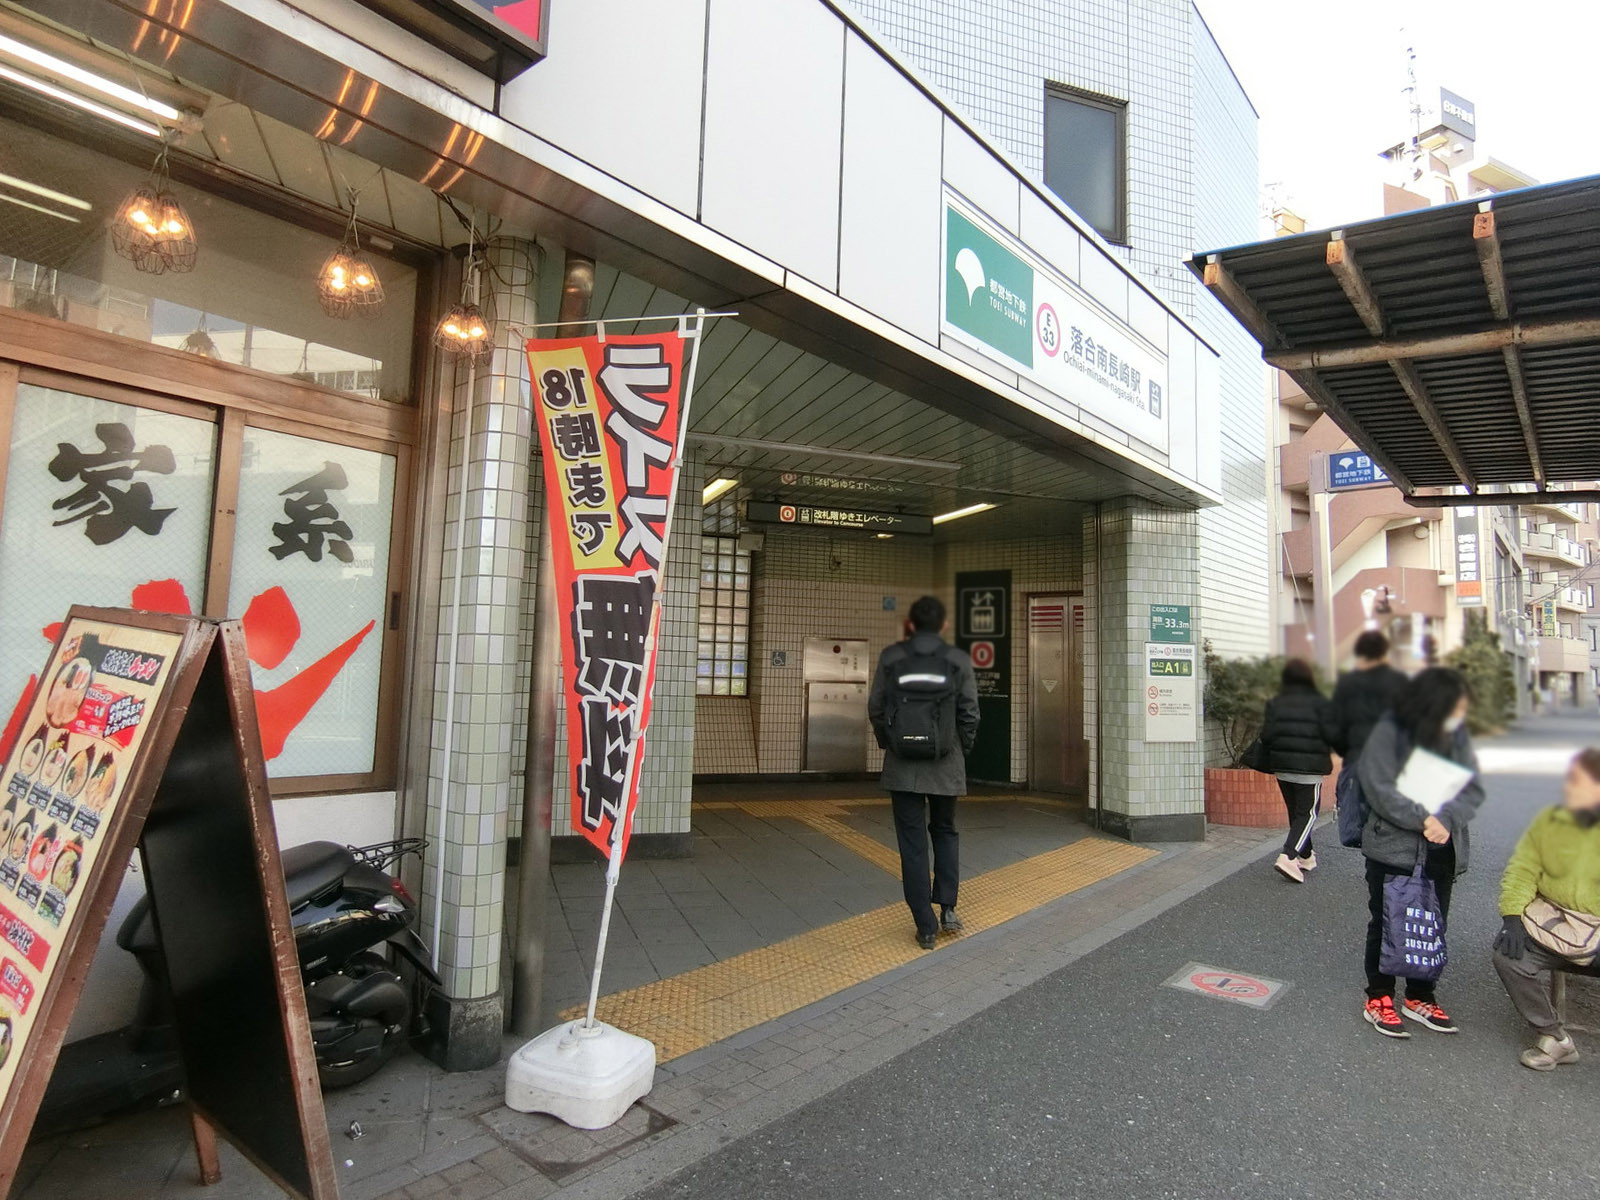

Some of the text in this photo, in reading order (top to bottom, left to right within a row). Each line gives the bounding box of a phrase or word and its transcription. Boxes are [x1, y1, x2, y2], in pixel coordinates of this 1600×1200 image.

[990, 278, 1027, 315] 都営地下鉄
[990, 296, 1027, 328] TOEI SUBWAY
[1046, 312, 1052, 327] E
[1043, 327, 1055, 347] 33
[1070, 325, 1141, 394] 落合南長崎駅
[1165, 617, 1190, 628] 33.3m
[1165, 662, 1180, 674] A1
[1406, 907, 1420, 918] WE
[1405, 922, 1433, 936] LIVE
